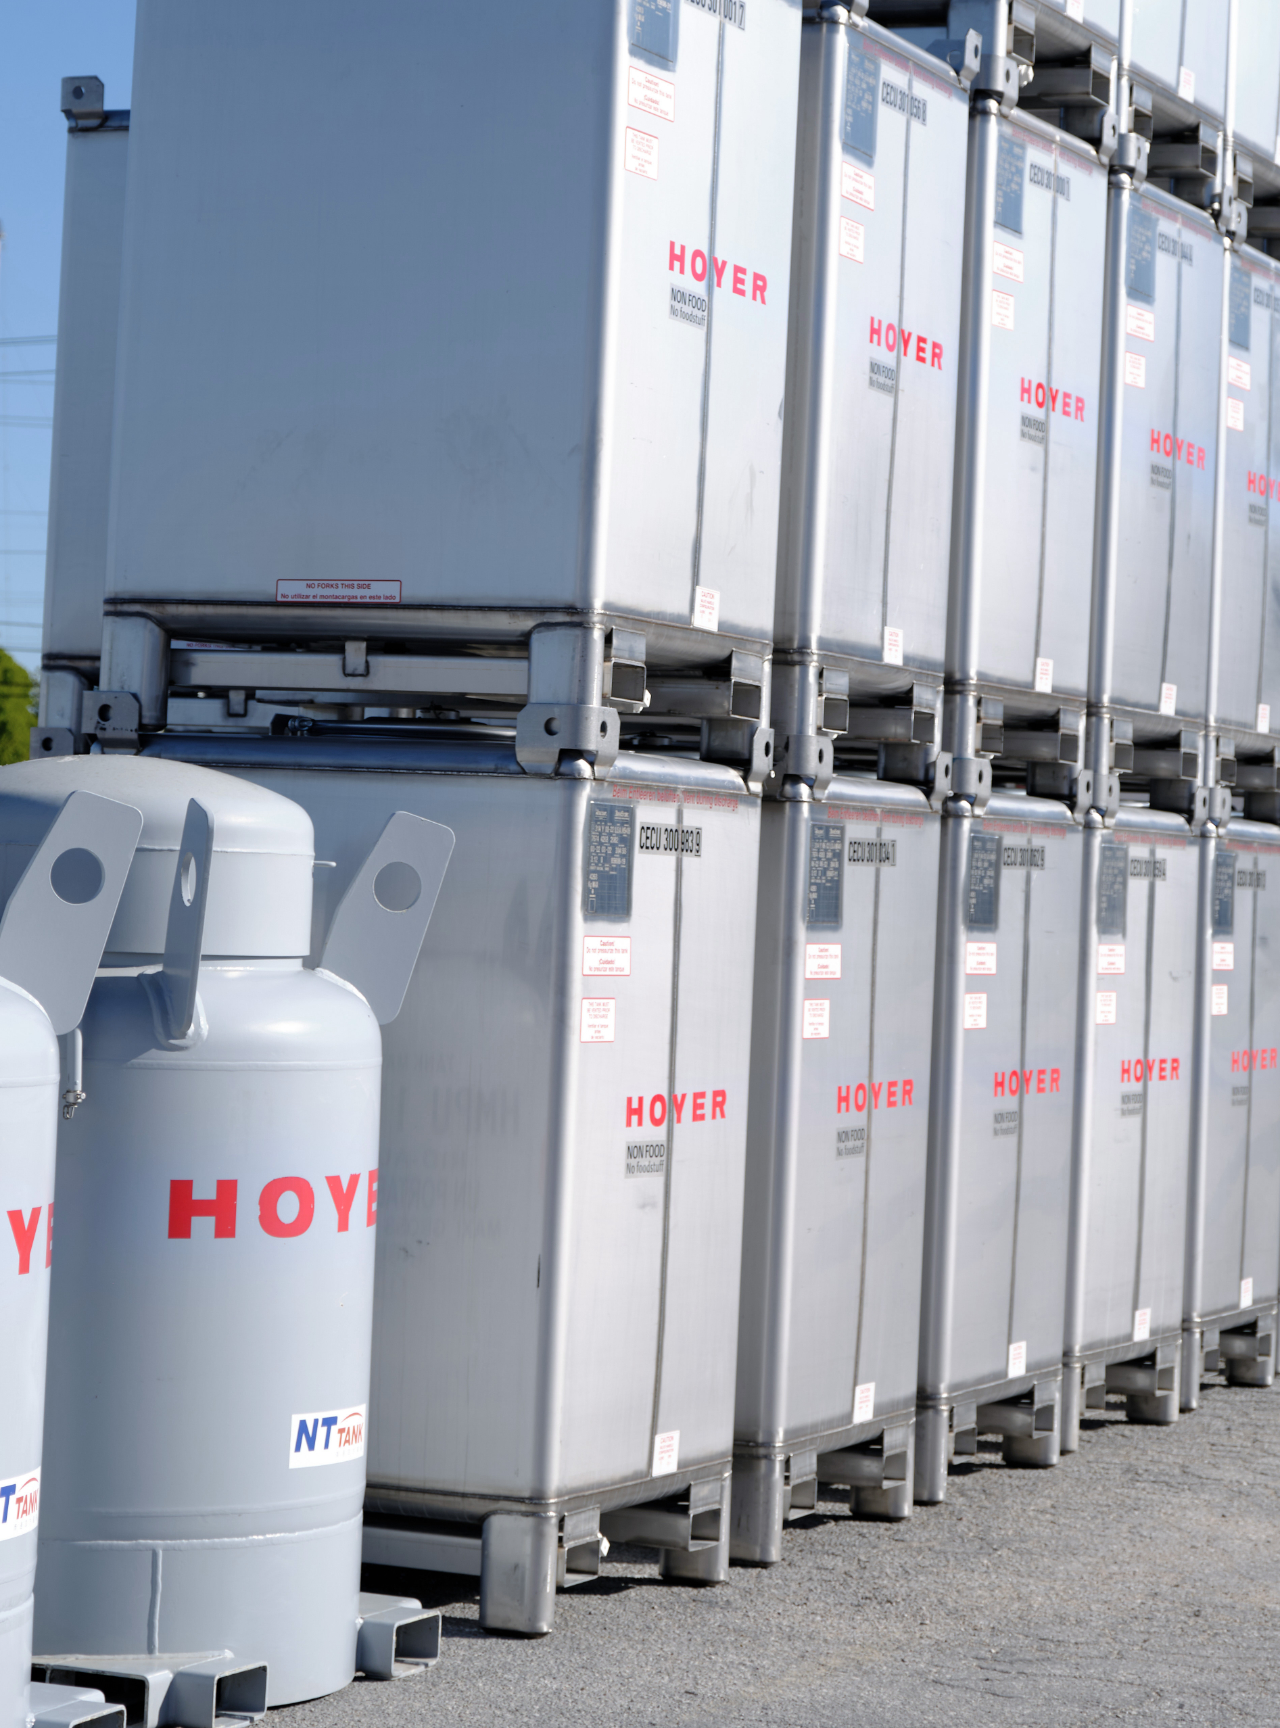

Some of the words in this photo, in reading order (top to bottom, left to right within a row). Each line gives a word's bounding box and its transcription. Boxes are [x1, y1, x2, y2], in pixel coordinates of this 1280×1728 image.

[881, 81, 898, 108] CECU
[1029, 163, 1045, 186] CECU
[668, 240, 768, 305] HOYER
[670, 286, 687, 306] NON
[688, 292, 707, 313] FOOD
[670, 303, 678, 317] No
[679, 305, 707, 328] foodstuff
[869, 316, 944, 370] HOYER
[870, 360, 882, 377] NON
[882, 365, 896, 382] FOOD
[1020, 377, 1086, 422] HOYER
[1021, 415, 1032, 429] NON
[1032, 418, 1046, 433] FOOD
[1150, 428, 1206, 470] HOYER
[612, 784, 627, 798] Beim
[628, 786, 656, 801] Entleeren
[681, 790, 696, 804] Vent
[696, 792, 713, 809] during
[714, 793, 739, 811] discharge
[639, 825, 661, 851] CECU
[664, 827, 678, 851] 300
[680, 829, 694, 853] 983
[848, 841, 866, 862] CECU
[866, 842, 877, 863] 301
[1003, 847, 1018, 866] CECU
[1130, 859, 1143, 876] CECU
[1120, 1057, 1181, 1084] HOYER
[1231, 1047, 1278, 1073] HOYER
[836, 1078, 914, 1114] HOYER
[993, 1067, 1061, 1098] HOYER
[625, 1089, 727, 1128] HOYER
[994, 1112, 1004, 1124] NON
[1005, 1110, 1018, 1123] FOOD
[837, 1130, 849, 1144] NON
[850, 1127, 865, 1142] FOOD
[626, 1145, 643, 1160] NON
[645, 1142, 665, 1159] FOOD
[626, 1160, 635, 1174] No
[636, 1159, 664, 1174] foodstuff
[294, 1416, 338, 1453] NT
[337, 1422, 363, 1448] TANK
